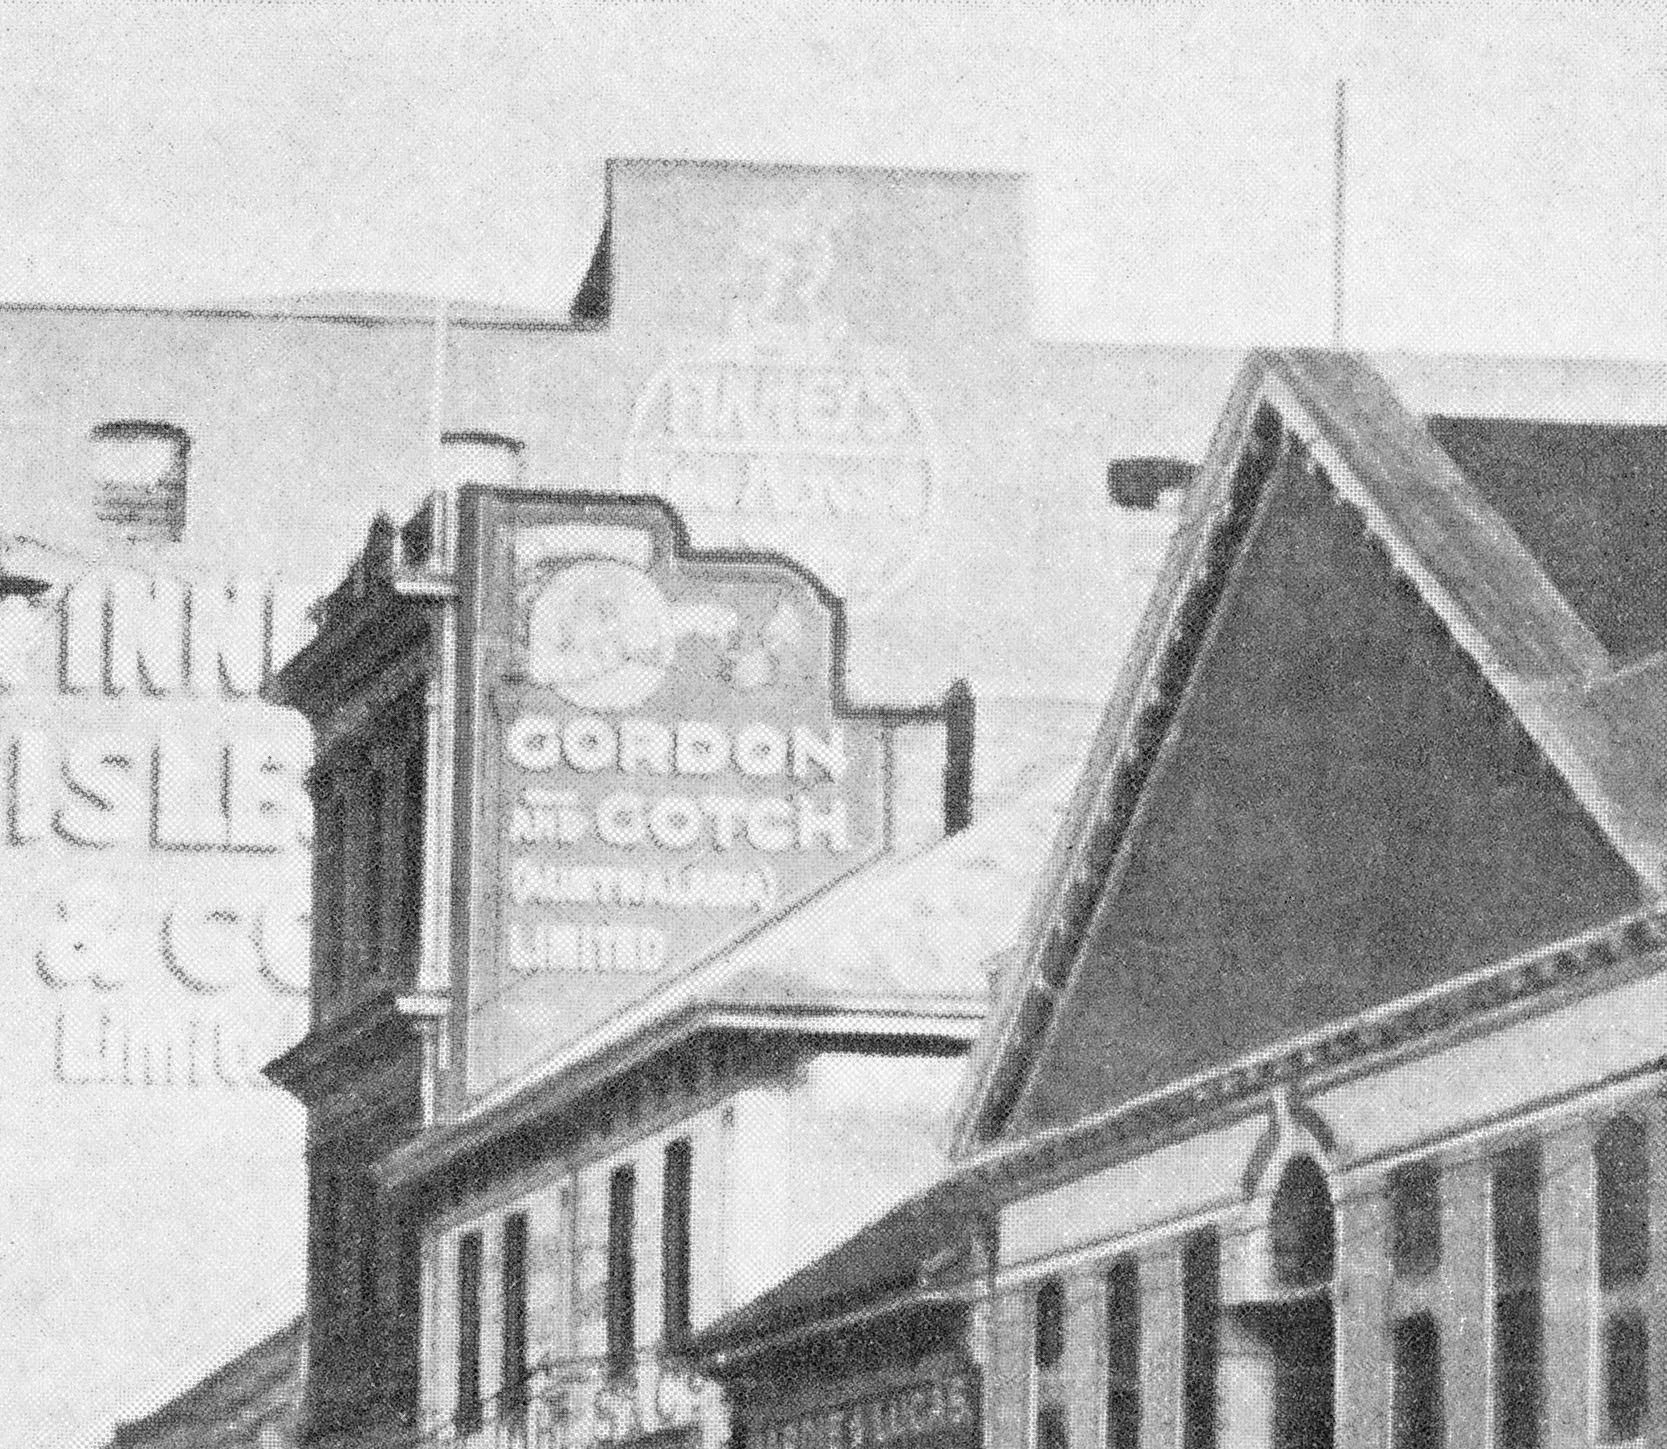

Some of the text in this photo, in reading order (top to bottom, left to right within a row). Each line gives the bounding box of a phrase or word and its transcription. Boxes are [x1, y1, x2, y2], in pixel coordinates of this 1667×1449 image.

[505, 713, 849, 781] GORDON
[7, 732, 315, 856] ISLE
[596, 791, 852, 852] GOTCH
[34, 882, 129, 992] &
